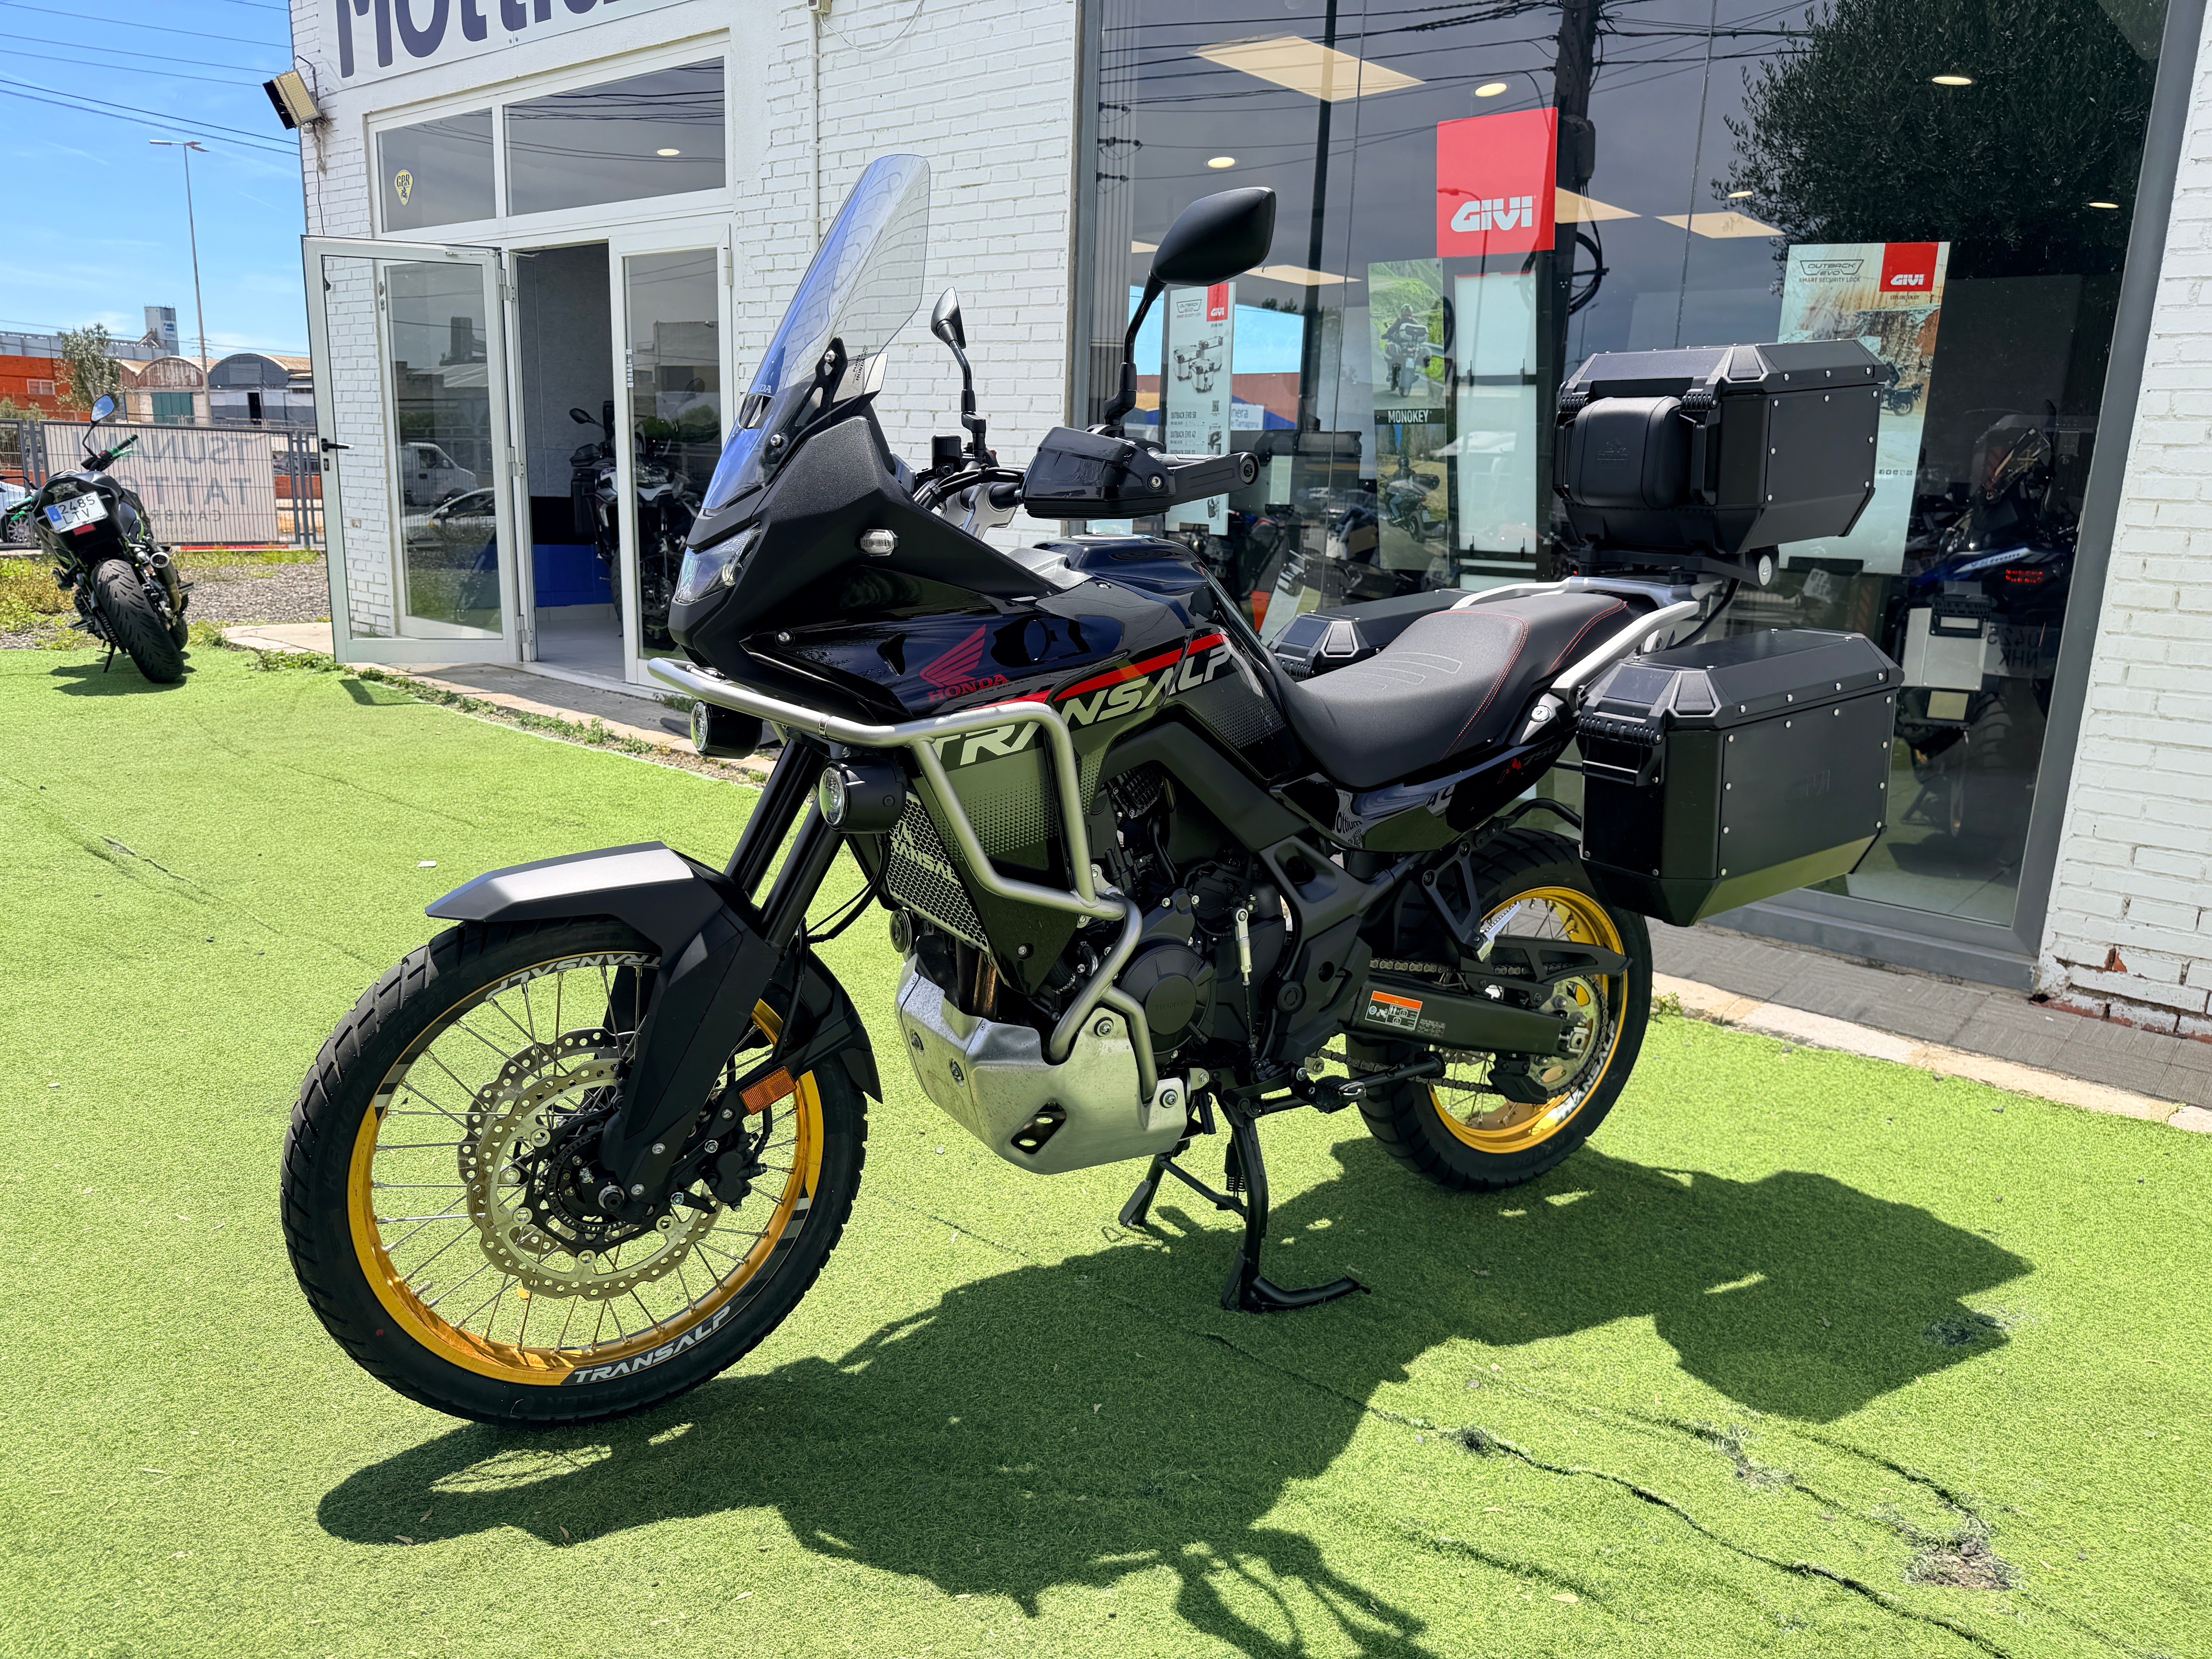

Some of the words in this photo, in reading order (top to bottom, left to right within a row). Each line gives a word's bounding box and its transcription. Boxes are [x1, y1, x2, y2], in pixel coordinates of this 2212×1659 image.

[397, 174, 410, 187] GPR
[1451, 196, 1533, 232] GIVI
[1890, 274, 1924, 286] GIVI
[1211, 307, 1224, 316] GIVI
[1388, 410, 1429, 423] MONOKEY
[58, 496, 95, 514] 2485
[63, 508, 89, 524] LTV
[926, 674, 1010, 702] HONDA
[1523, 741, 1562, 767] 750
[890, 836, 962, 884] RANSAL
[485, 954, 661, 1000] TRANSALP
[575, 1306, 731, 1383] TRANSALP
